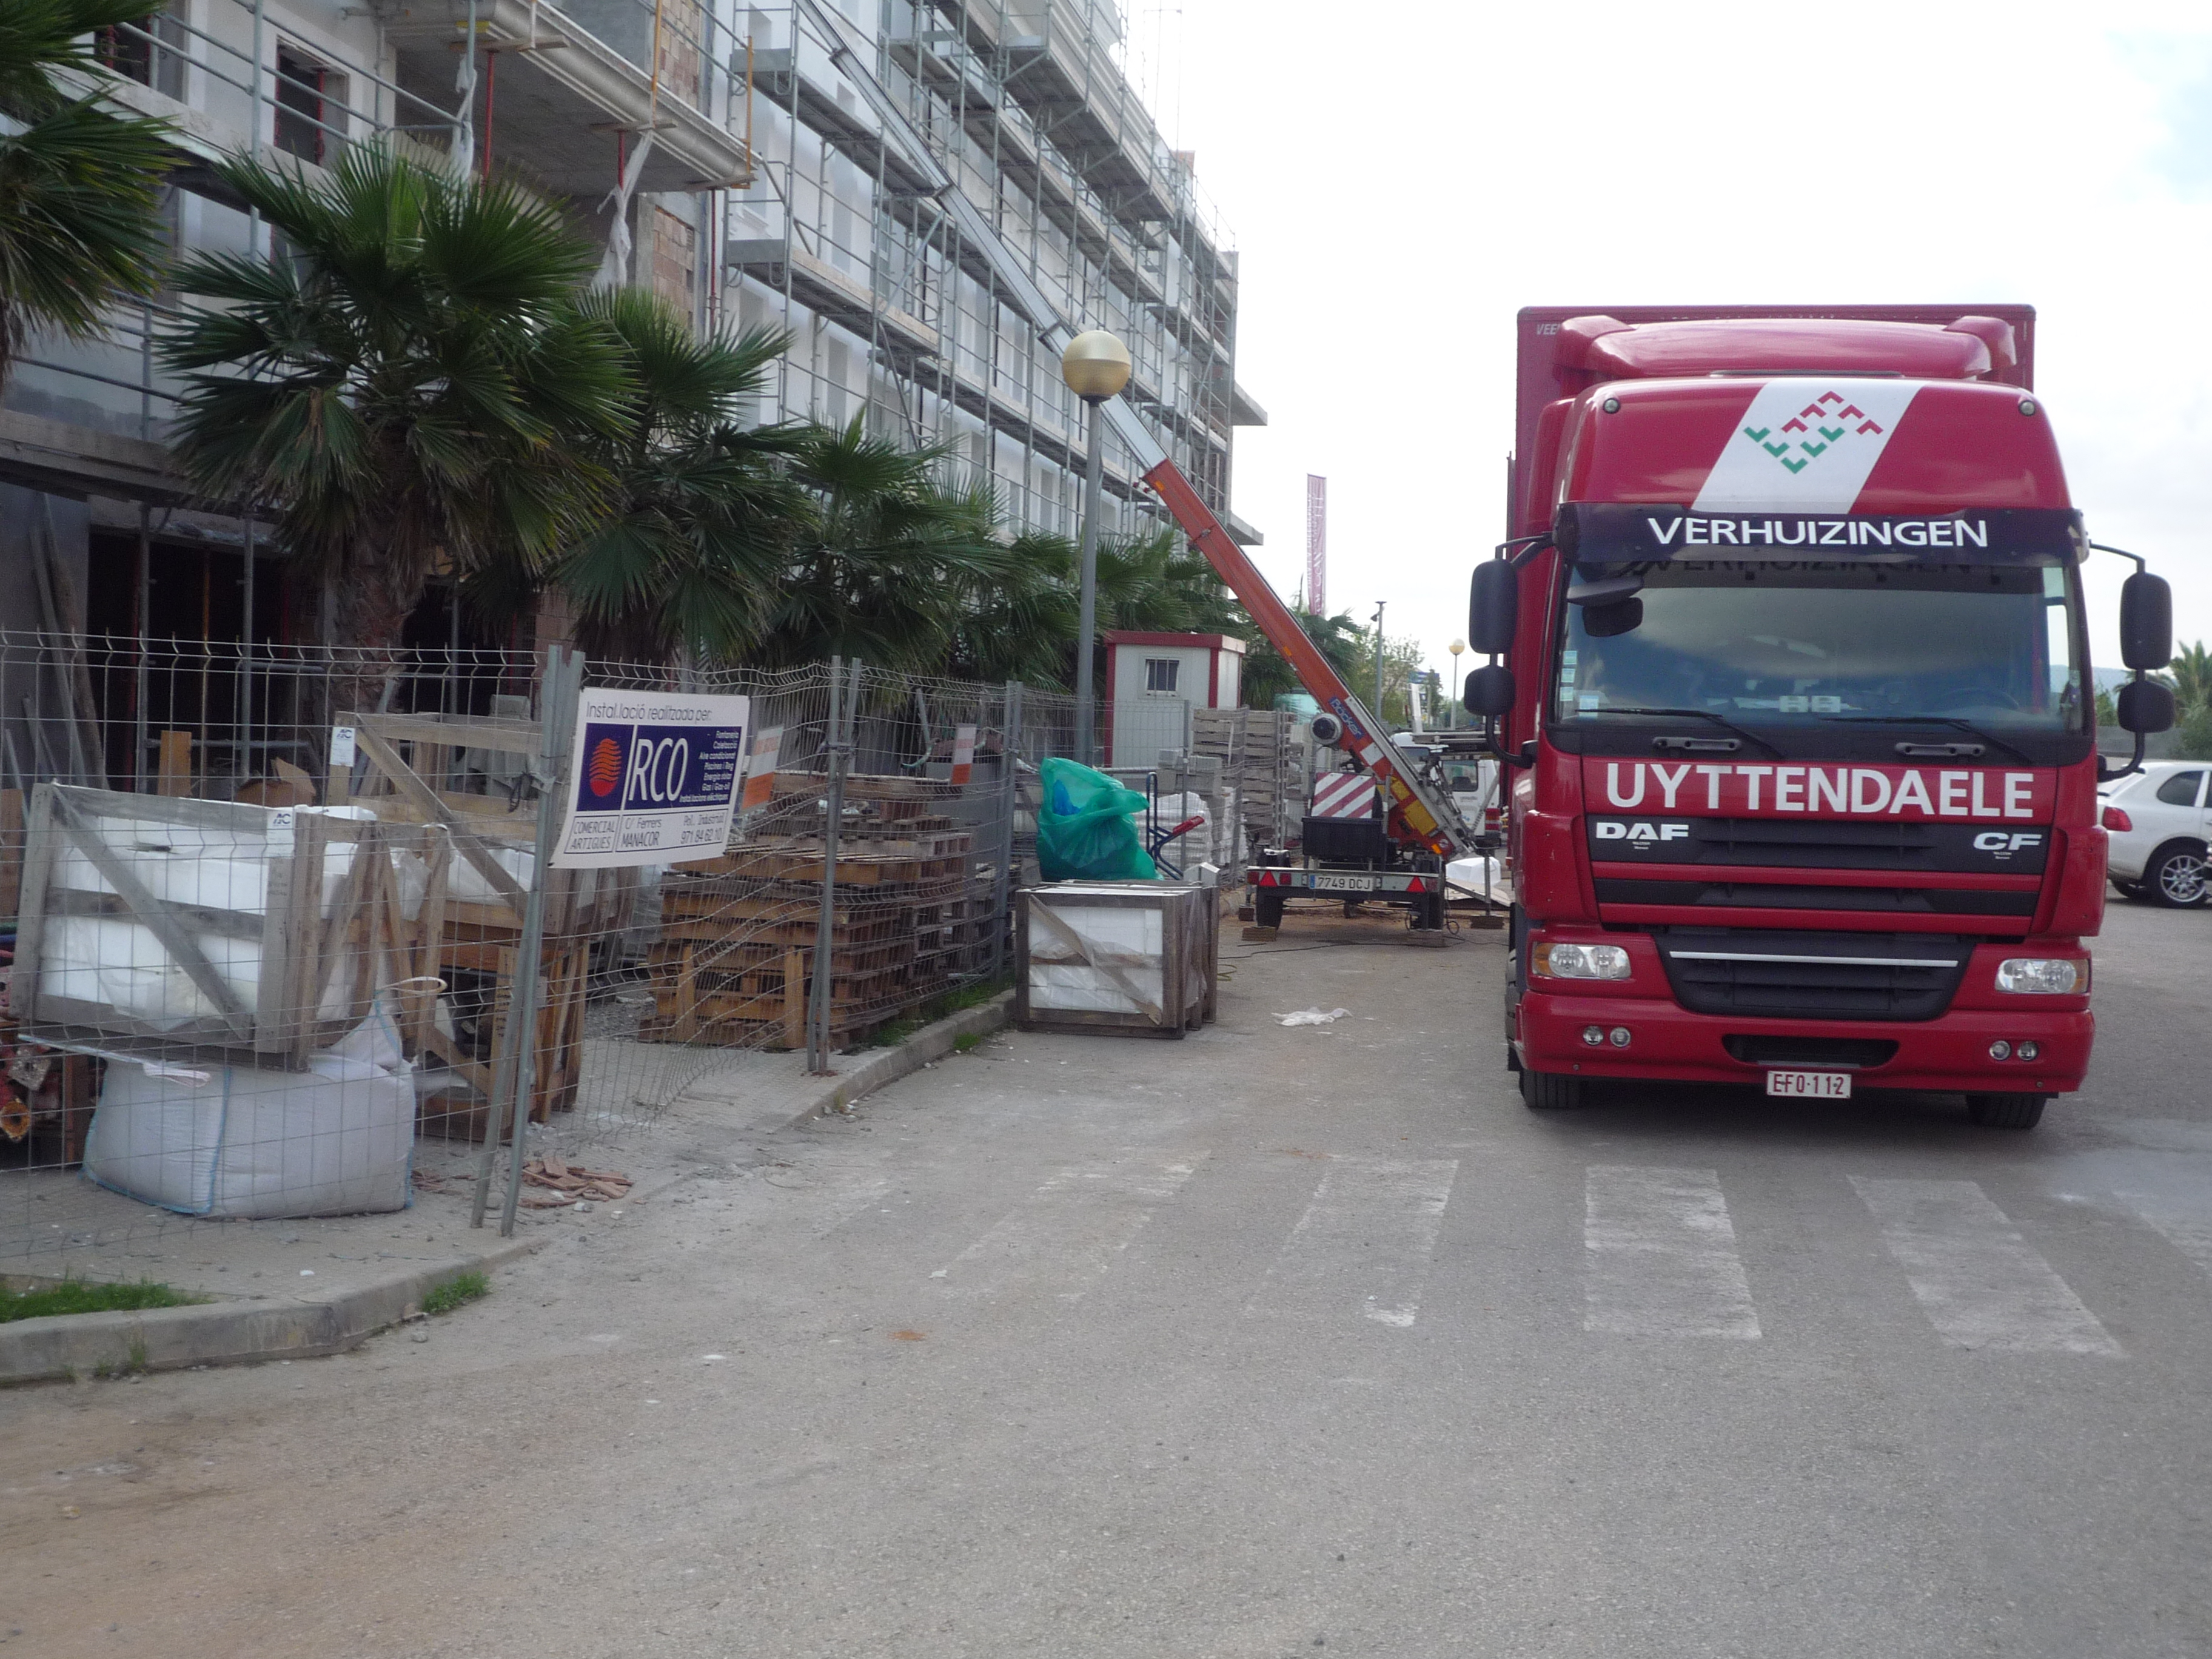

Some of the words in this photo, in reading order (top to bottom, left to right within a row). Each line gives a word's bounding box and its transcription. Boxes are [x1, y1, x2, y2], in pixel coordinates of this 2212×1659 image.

[1648, 517, 1988, 547] VERHUIZINGEN
[586, 702, 645, 720] Instal.lació
[648, 705, 694, 721] realitzada
[1607, 763, 2034, 817] UYTTENDAELE
[574, 820, 615, 834] COMERCIAL
[637, 817, 662, 829] Ferrers
[697, 812, 724, 825] Industrial
[621, 831, 660, 848] MANACOR
[680, 831, 694, 844] 971
[1596, 822, 1689, 840] DAF
[571, 836, 612, 850] ARTIGUES
[1973, 833, 2042, 850] CF
[1318, 877, 1346, 888] 7749
[1349, 878, 1370, 890] DCJ
